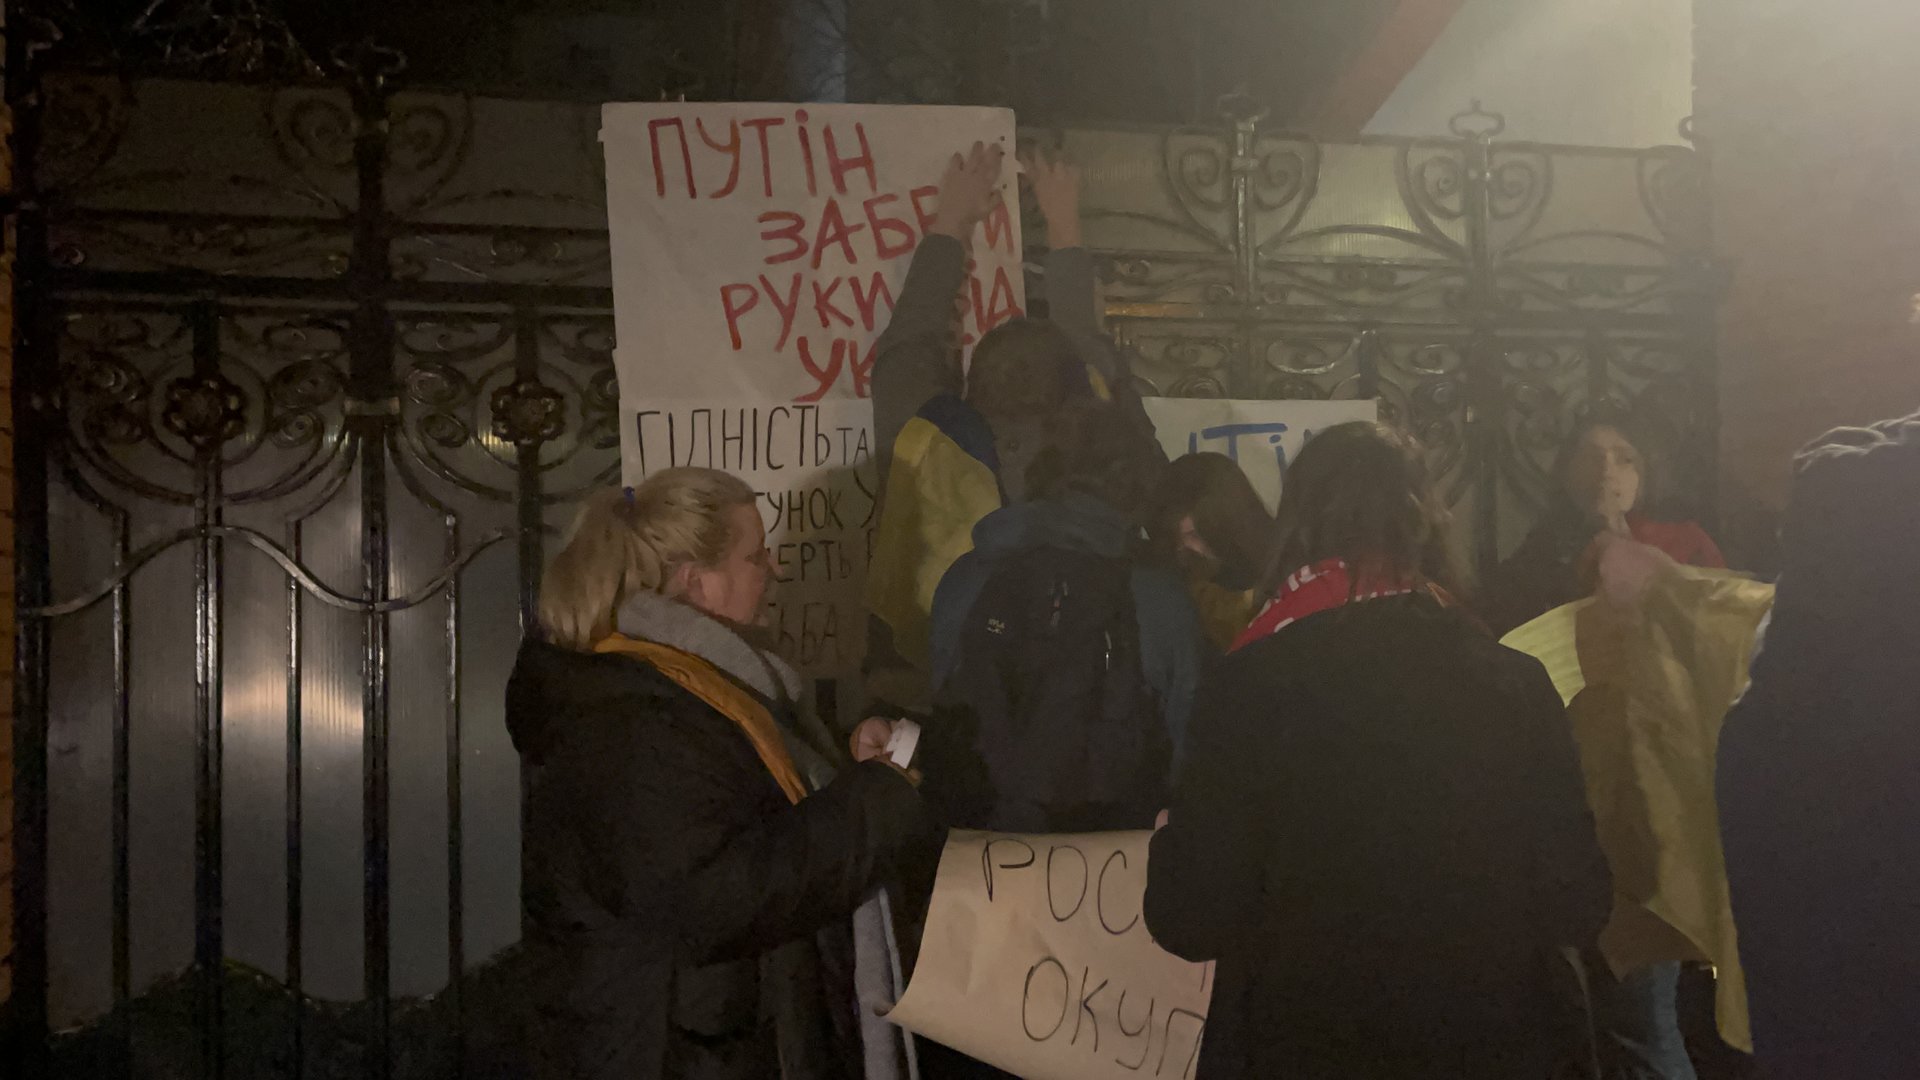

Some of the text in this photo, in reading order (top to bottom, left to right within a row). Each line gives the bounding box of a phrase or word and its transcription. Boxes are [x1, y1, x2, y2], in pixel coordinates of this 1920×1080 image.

[756, 184, 1015, 270] ЗАБЕИ
[981, 838, 1140, 936] РОС
[1021, 955, 1207, 1080] ОКУП
